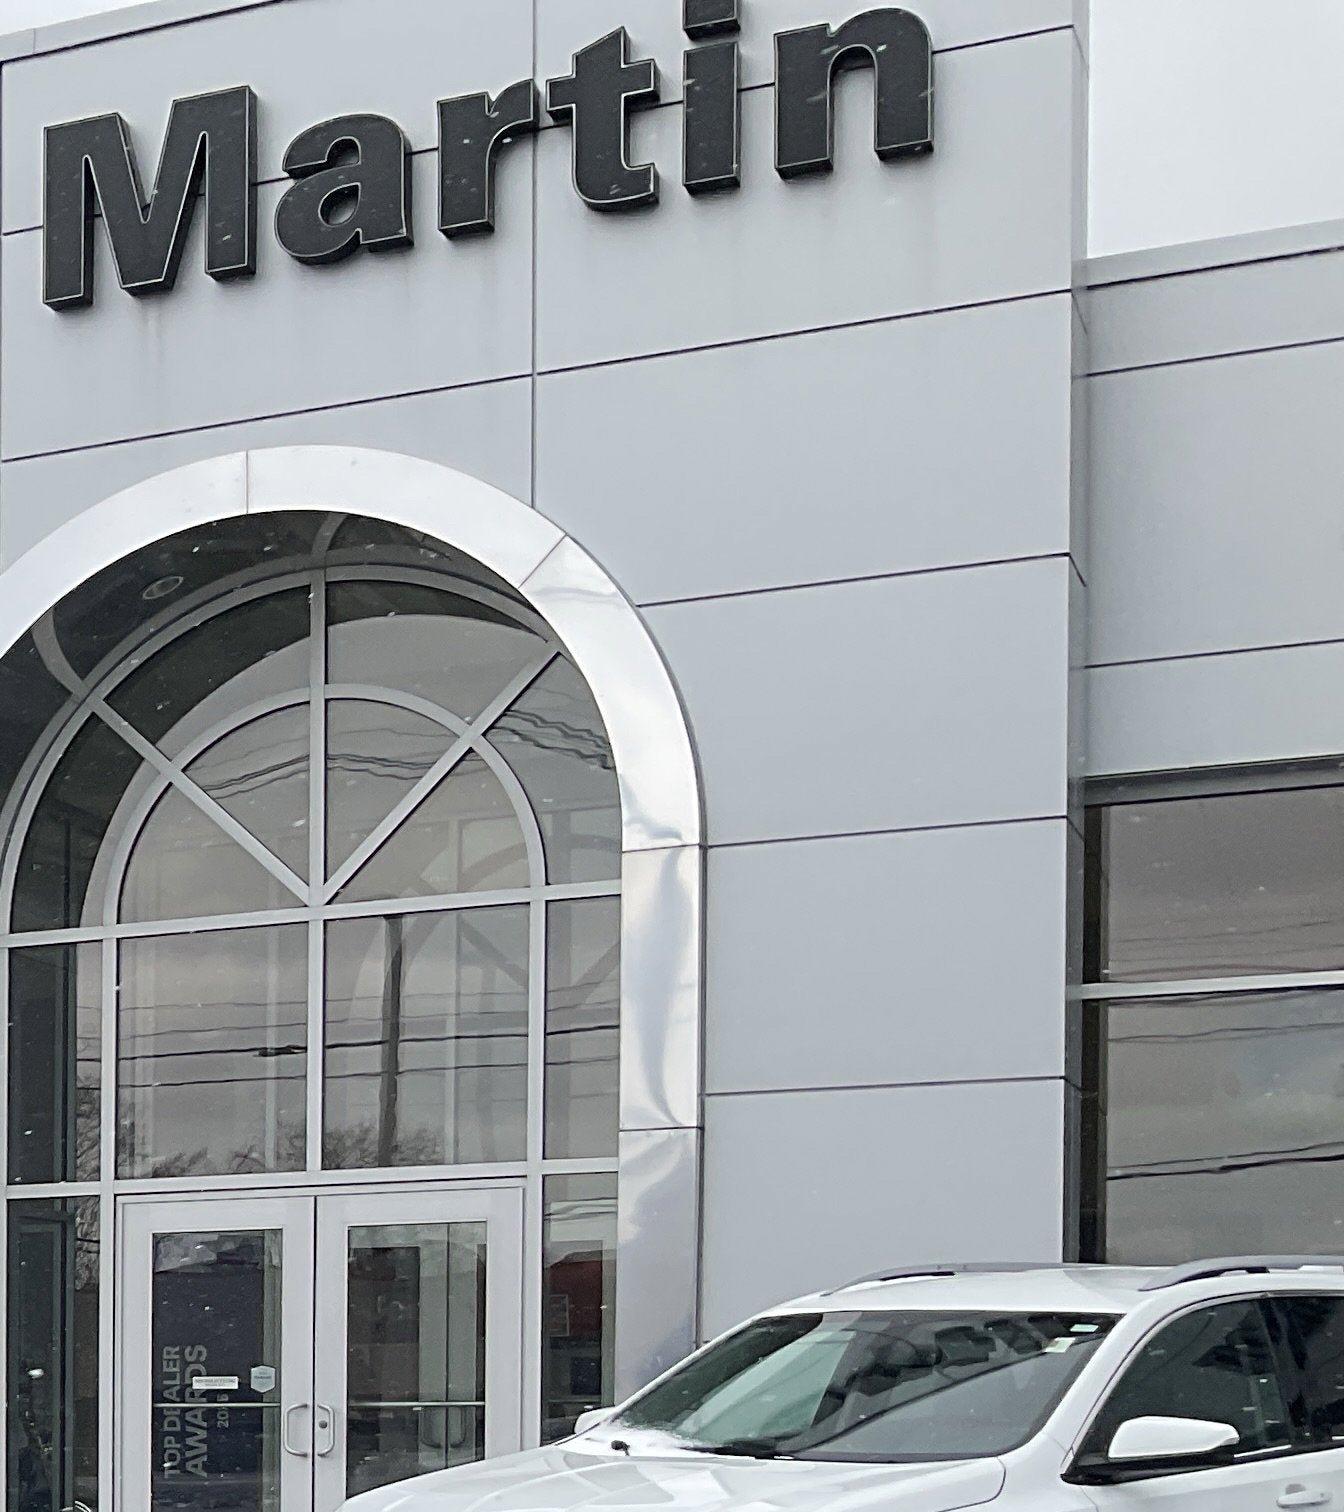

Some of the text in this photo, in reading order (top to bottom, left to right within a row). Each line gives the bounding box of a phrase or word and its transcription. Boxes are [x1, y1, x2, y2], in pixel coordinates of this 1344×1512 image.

[43, 0, 935, 311] Martin
[163, 1435, 181, 1478] TOP
[184, 1344, 208, 1478] AWARDS
